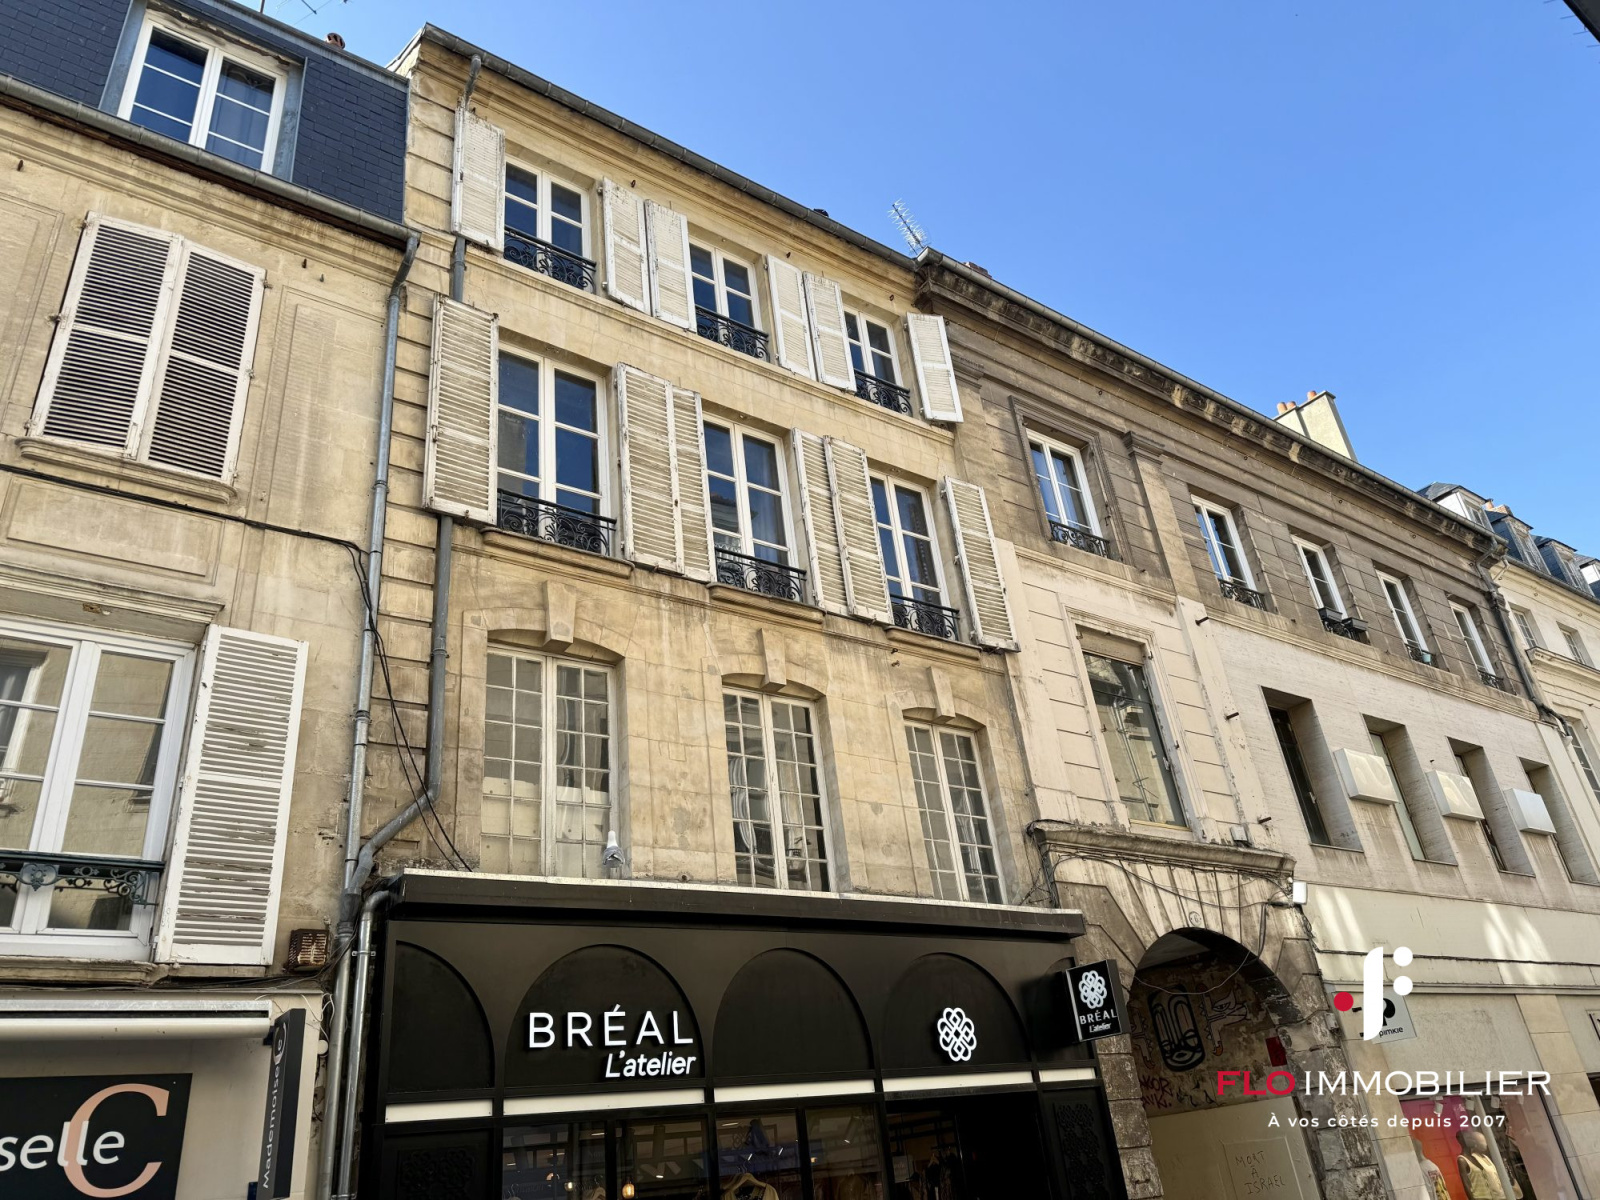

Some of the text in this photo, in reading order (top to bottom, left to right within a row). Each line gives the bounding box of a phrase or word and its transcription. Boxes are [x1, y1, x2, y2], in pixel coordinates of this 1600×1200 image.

[529, 1004, 694, 1048] BRÉAL
[1079, 1010, 1118, 1025] BRÉAL
[1379, 1026, 1404, 1037] pimkie
[605, 1050, 697, 1078] L'atelier
[1244, 1174, 1286, 1195] ISRAEL
